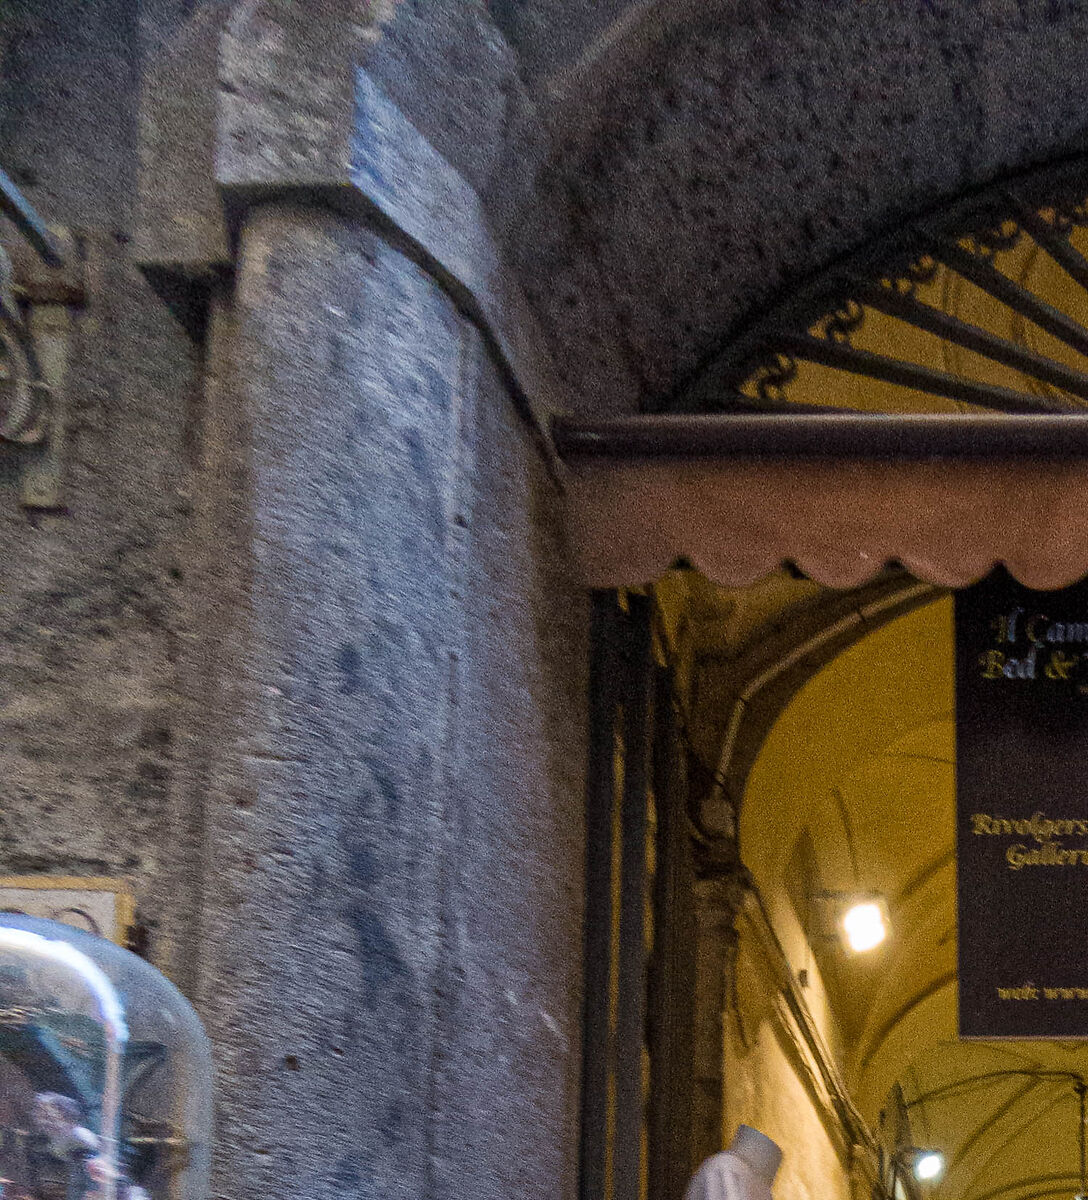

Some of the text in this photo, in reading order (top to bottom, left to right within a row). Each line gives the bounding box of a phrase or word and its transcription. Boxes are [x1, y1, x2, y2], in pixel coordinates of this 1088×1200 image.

[990, 606, 1024, 643] Il
[977, 643, 1038, 680] Bed
[1044, 649, 1079, 679] &
